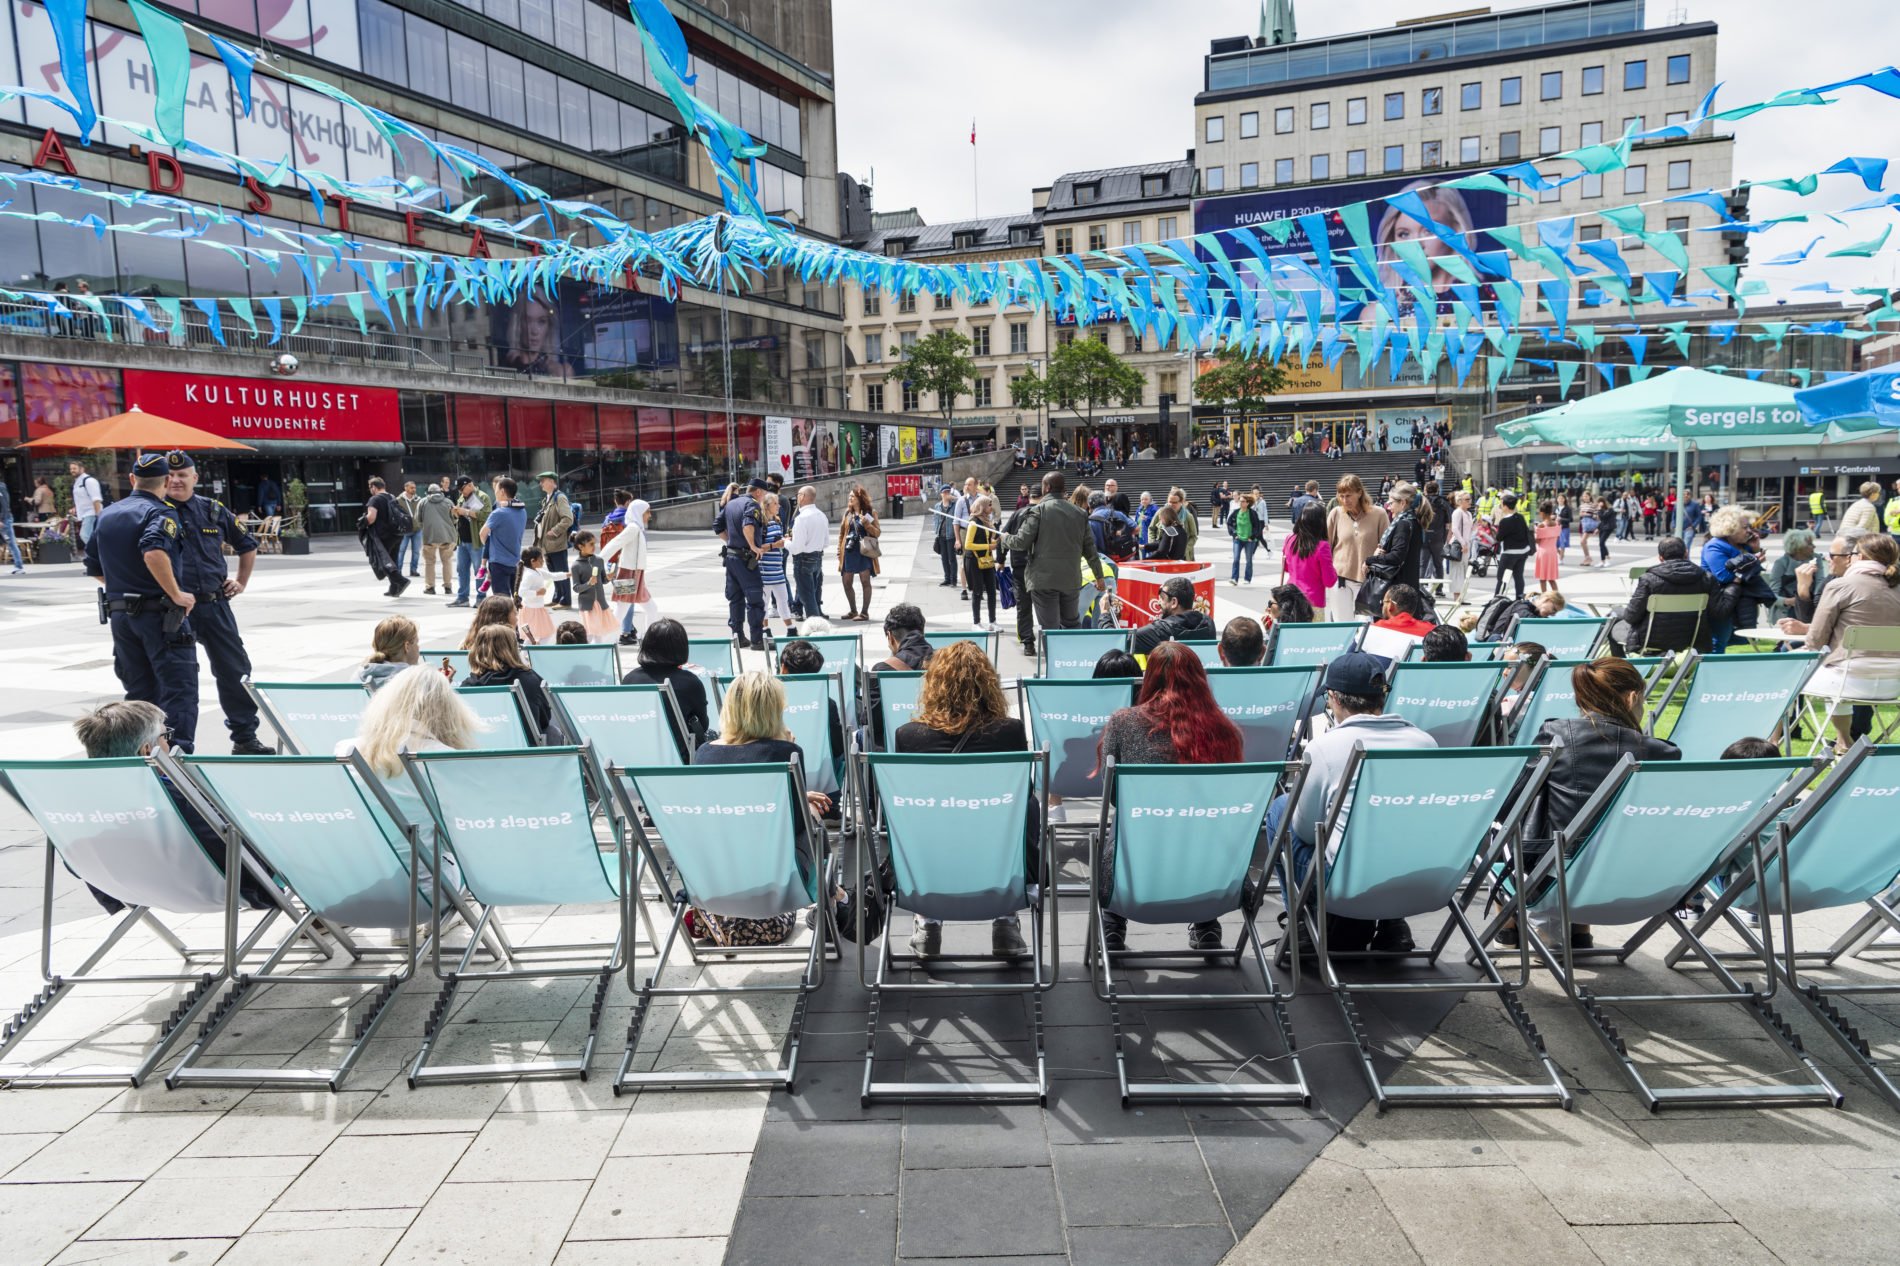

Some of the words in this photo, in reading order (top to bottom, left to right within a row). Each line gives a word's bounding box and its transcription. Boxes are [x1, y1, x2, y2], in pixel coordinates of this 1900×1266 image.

[126, 58, 218, 114] HA
[225, 89, 384, 160] STOCKHOLM
[1235, 209, 1286, 224] HUAWEI
[1291, 206, 1311, 217] P30
[185, 383, 360, 411] KULTURHUSET
[231, 415, 327, 431] HUVUDENTRÉ
[1684, 407, 1766, 428] Sergels
[1771, 408, 1808, 424] tor
[1834, 465, 1880, 473] T-Centralen
